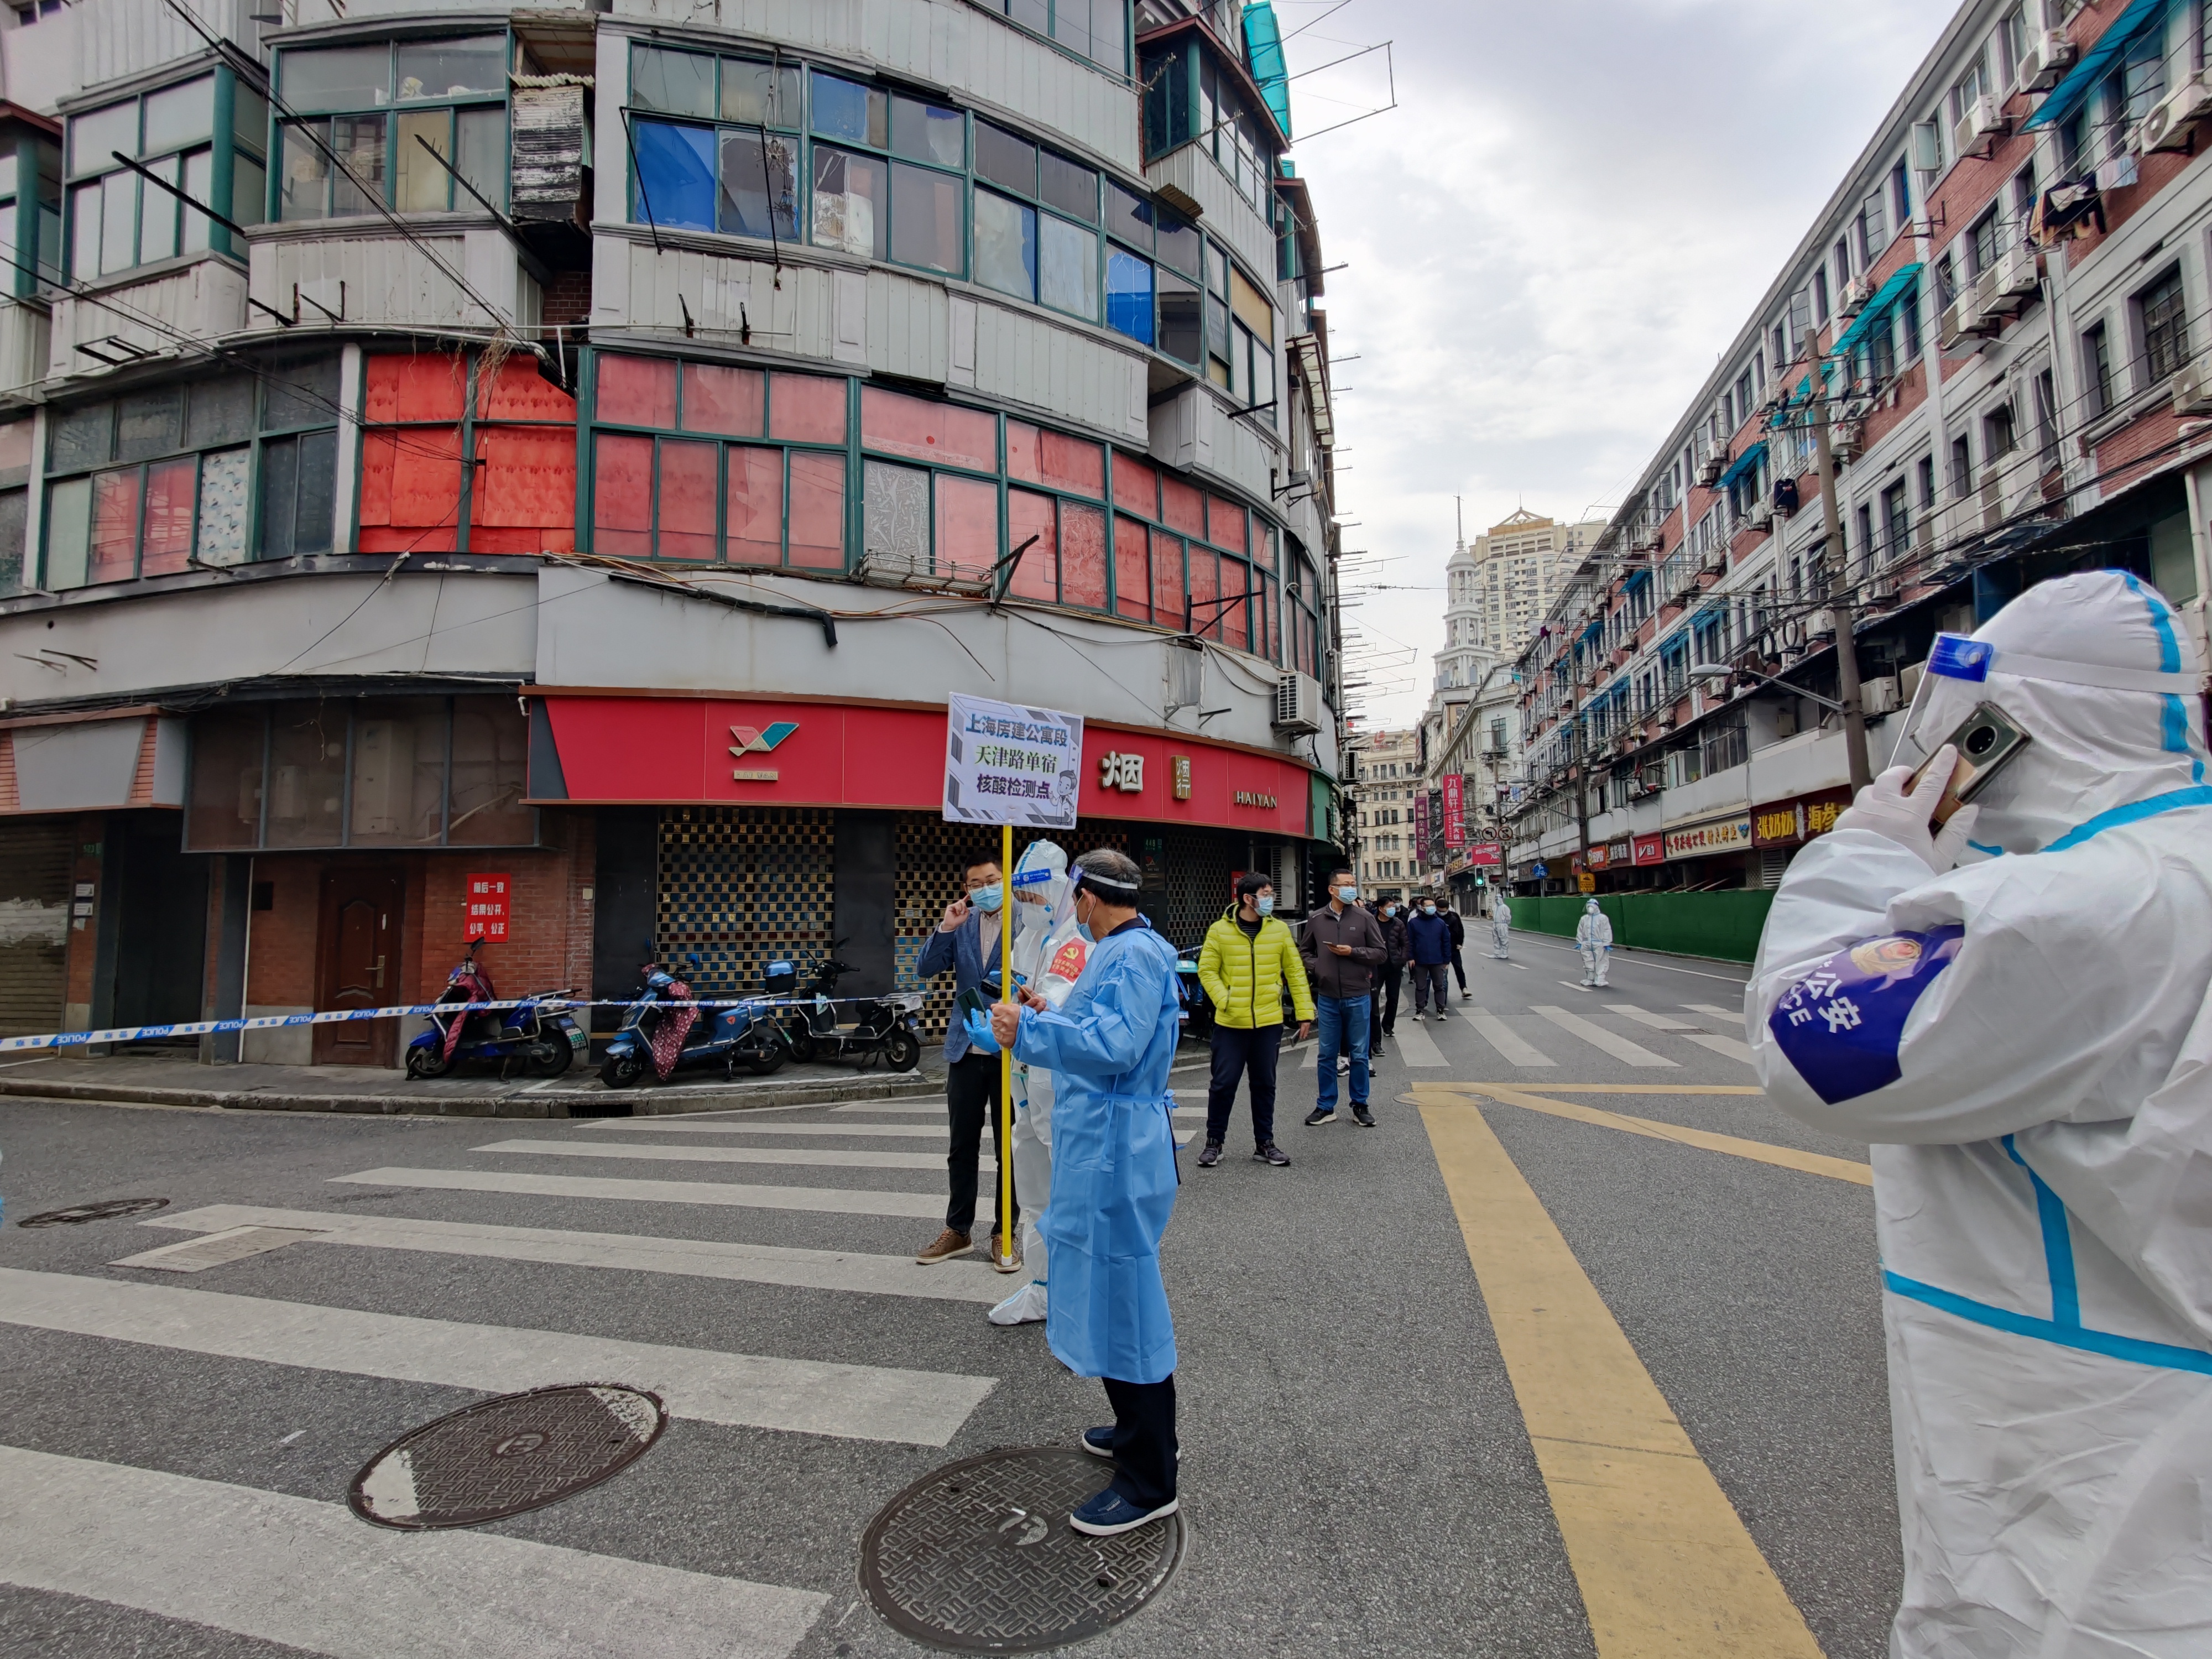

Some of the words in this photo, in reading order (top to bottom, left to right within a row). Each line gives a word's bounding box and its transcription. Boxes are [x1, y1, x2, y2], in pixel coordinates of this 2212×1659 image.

[966, 713, 1068, 747] 上海房建公寓段
[974, 745, 1057, 774] 天津路单宿
[1100, 751, 1145, 793] 烟
[977, 773, 1050, 799] 核酸检测点
[1236, 791, 1277, 809] HAIYAN
[1757, 810, 1793, 841] 张奶奶
[1808, 802, 1847, 832] 海参
[289, 1015, 312, 1023] POLICE
[353, 1009, 375, 1018] POLICE
[142, 1026, 169, 1036] POLICE
[218, 1020, 244, 1030] POLICE
[57, 1034, 87, 1044] POLICE
